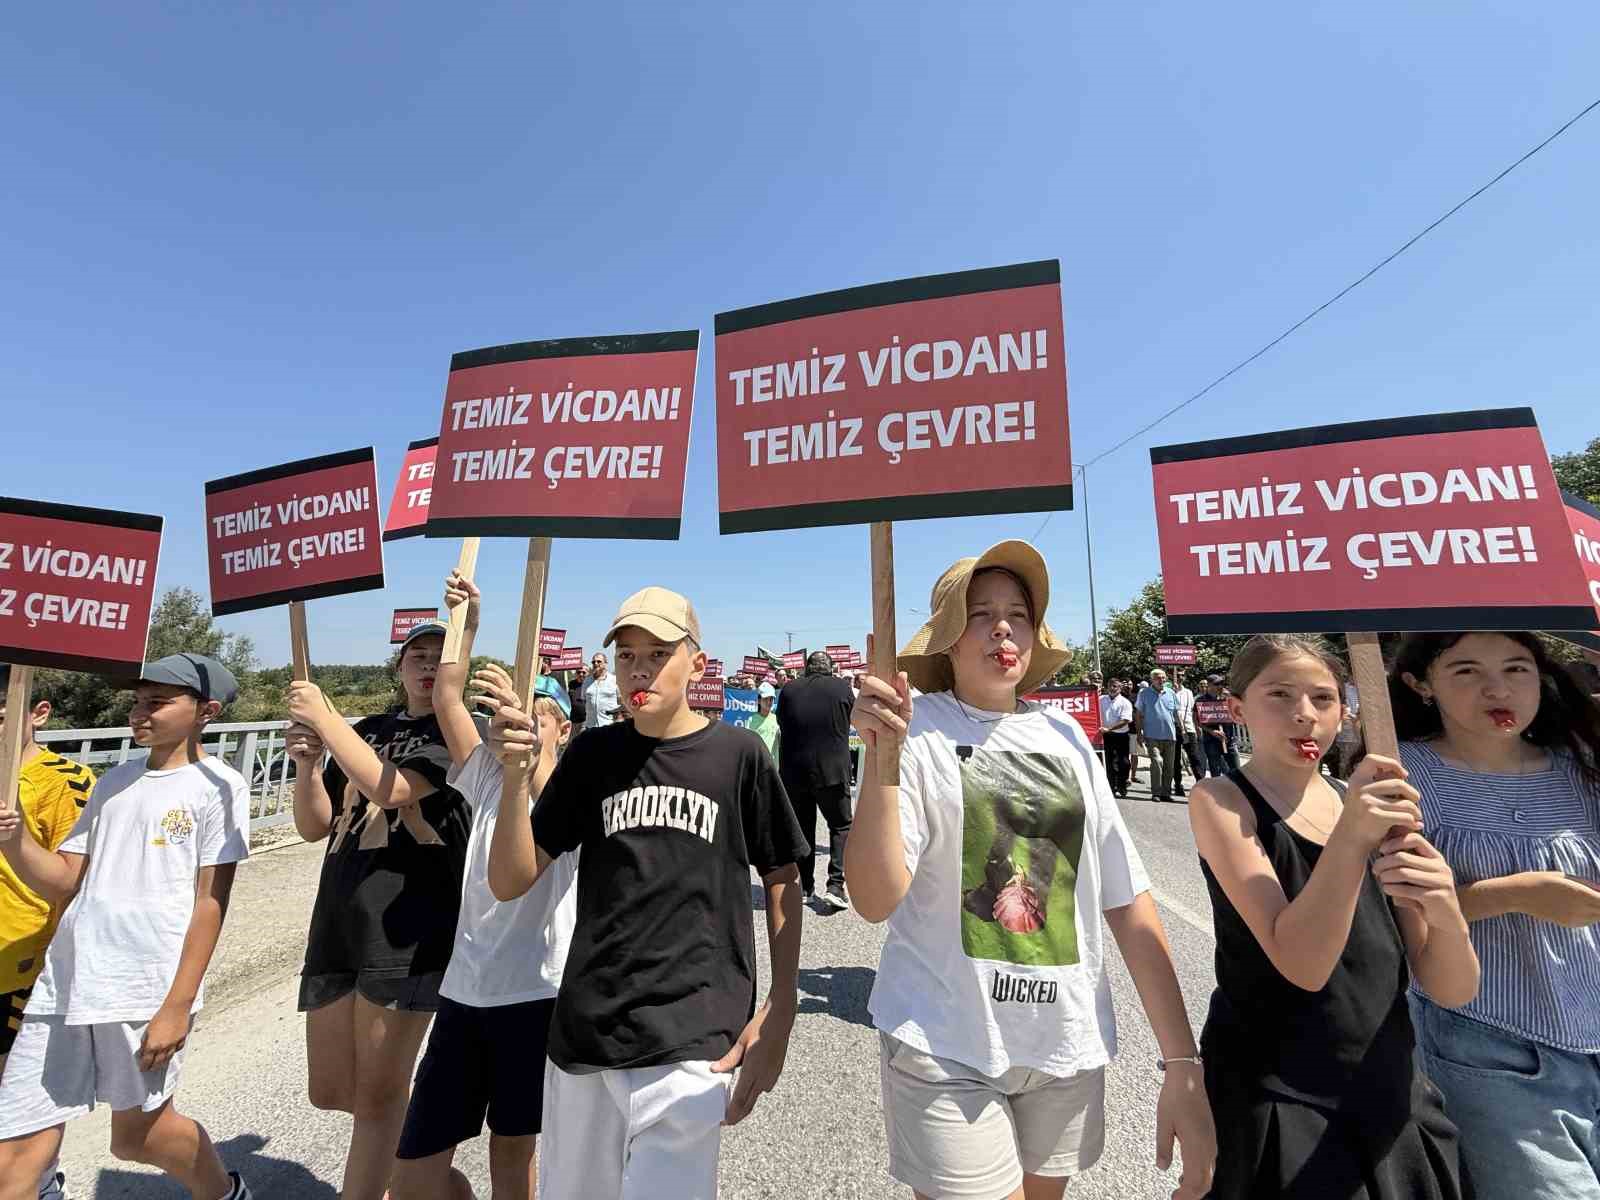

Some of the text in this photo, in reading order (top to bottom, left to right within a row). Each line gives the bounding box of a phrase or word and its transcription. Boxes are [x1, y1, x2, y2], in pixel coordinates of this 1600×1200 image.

[729, 329, 1048, 405] TEMİZ VİCDAN!
[451, 382, 682, 431] TEMİZ VİCDAN!
[743, 400, 1036, 466] TEMİZ ÇEVRE!
[408, 462, 435, 480] TE
[452, 440, 664, 489] TEMİZ ÇEVRE!
[212, 486, 369, 538] TEMİZ VİCDAN!
[1169, 464, 1539, 523] TEMİZ VİCDAN!
[22, 540, 147, 586] VİCDAN!
[221, 527, 365, 575] TEMİZ ÇEVRE!
[1190, 526, 1539, 581] TEMİZ ÇEVRE!
[24, 592, 130, 630] ÇEVRE!
[601, 785, 720, 844] BROOKLYN
[992, 969, 1058, 1004] WICKED
